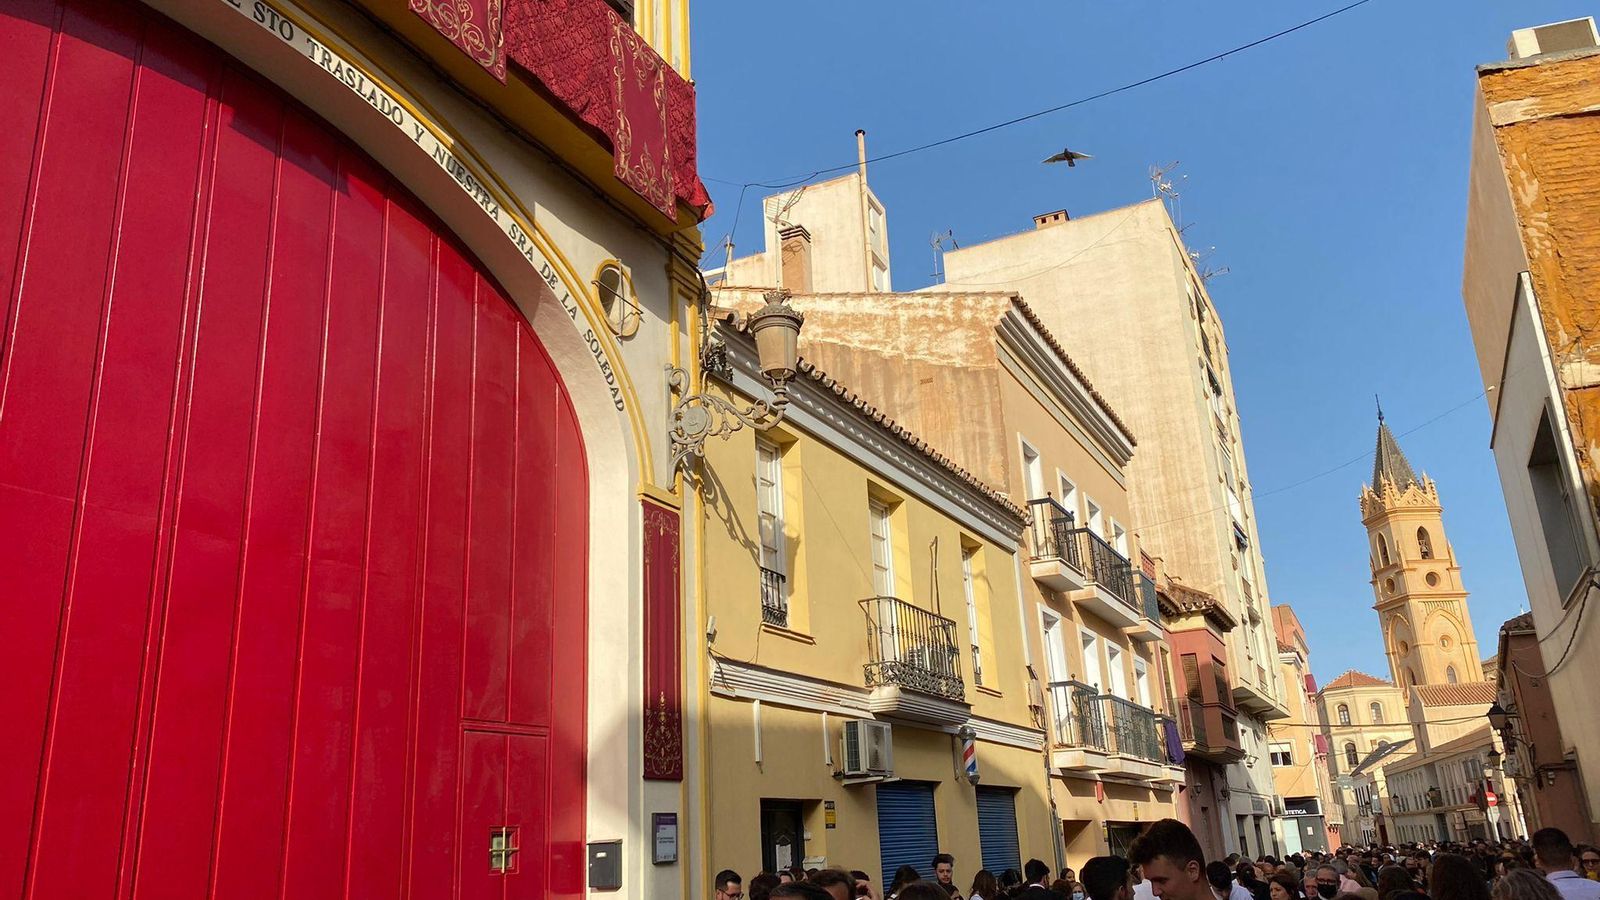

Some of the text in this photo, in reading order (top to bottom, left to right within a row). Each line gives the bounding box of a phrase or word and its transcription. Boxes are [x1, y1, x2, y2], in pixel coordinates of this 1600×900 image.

[253, 1, 625, 412] STO TRASLADO Y NUESTRA SRA DE LA SOLEDAD
